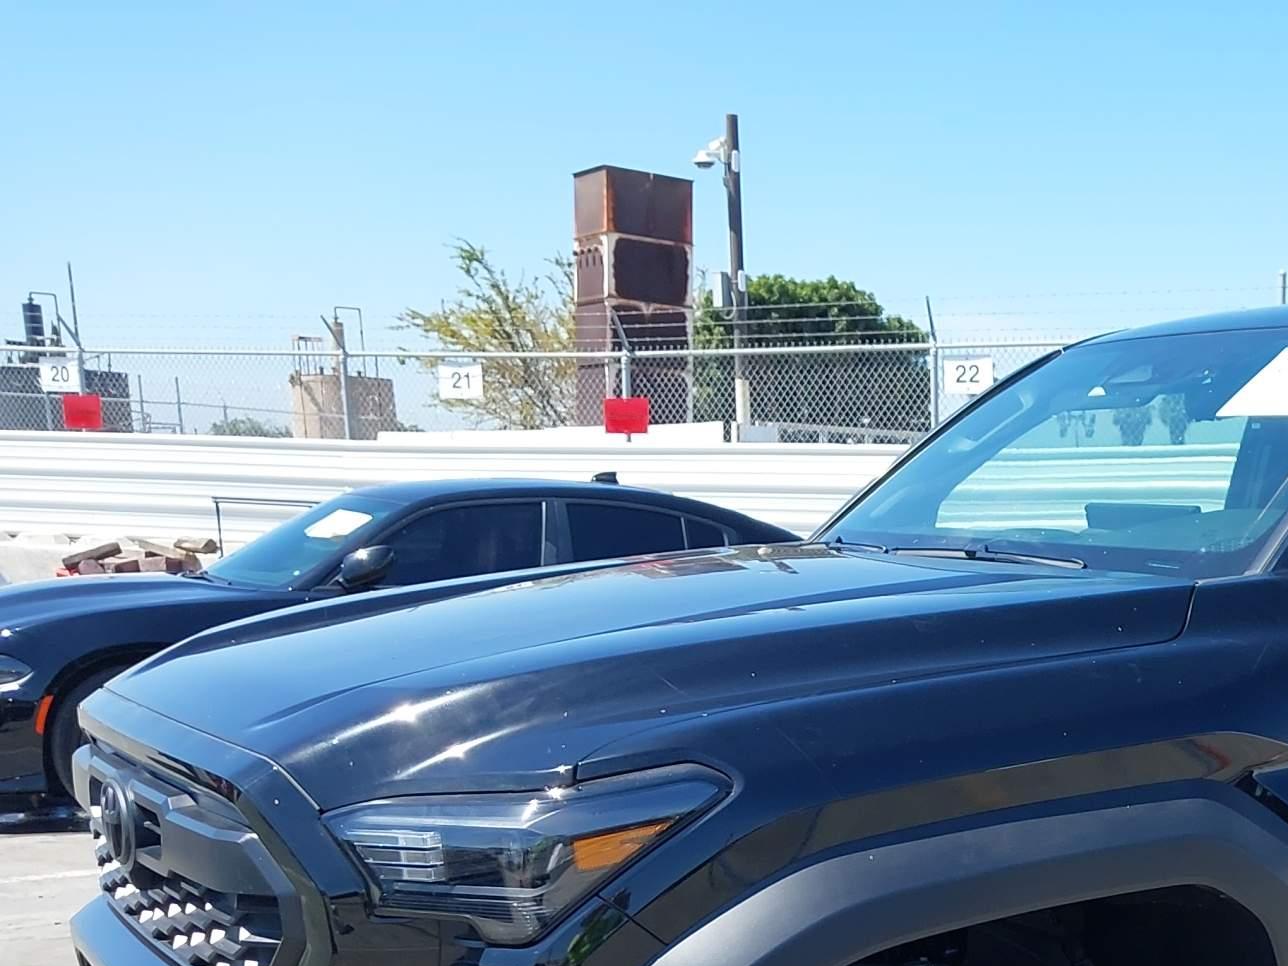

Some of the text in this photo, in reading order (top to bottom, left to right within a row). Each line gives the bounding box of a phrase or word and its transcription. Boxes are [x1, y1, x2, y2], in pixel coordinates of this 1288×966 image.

[50, 365, 70, 383] 20
[451, 370, 471, 390] 21
[955, 364, 980, 384] 22
